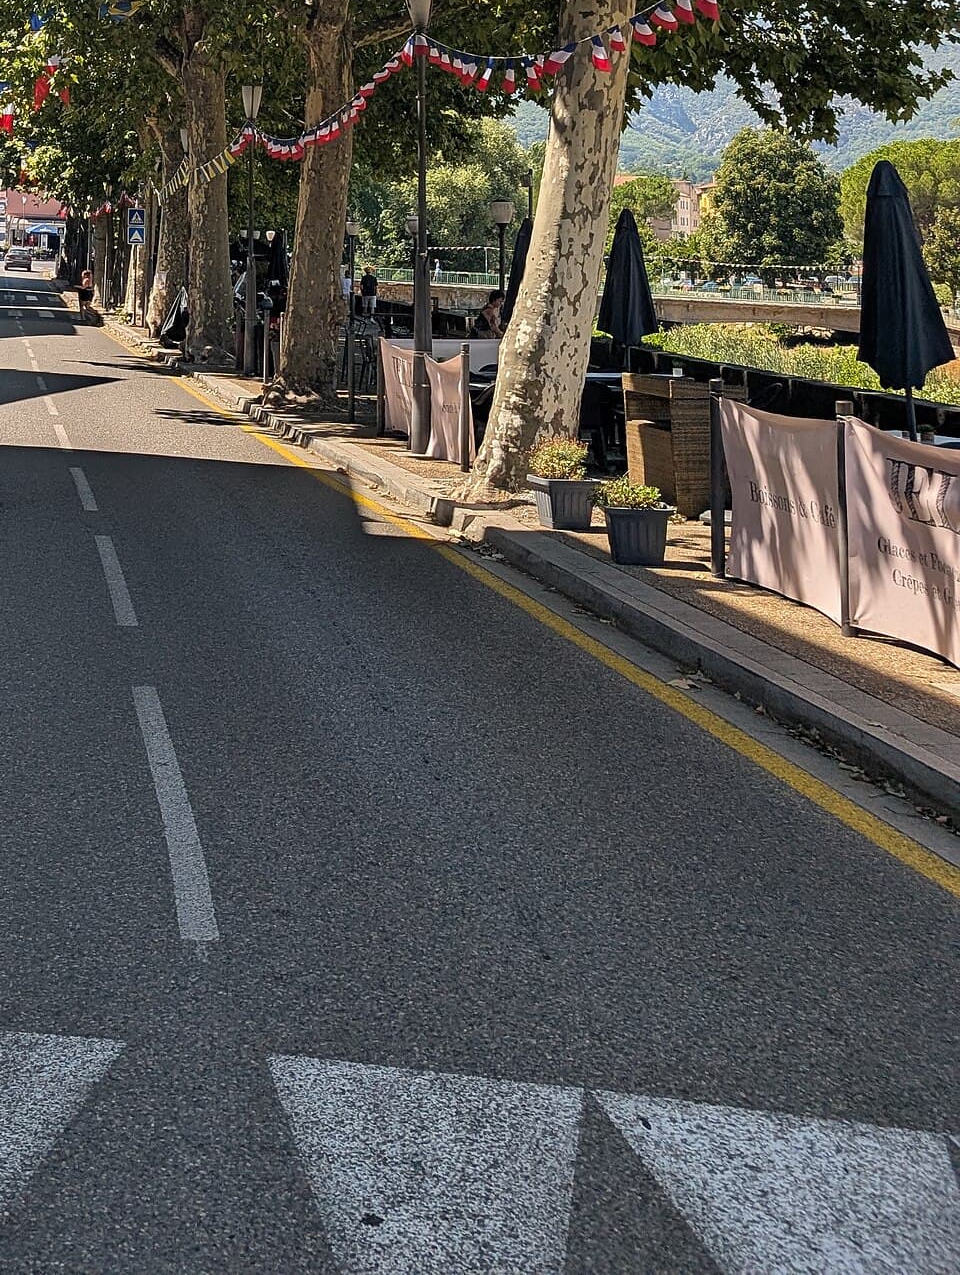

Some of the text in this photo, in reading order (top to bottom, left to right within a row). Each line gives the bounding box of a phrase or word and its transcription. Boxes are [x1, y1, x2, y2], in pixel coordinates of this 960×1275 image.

[749, 481, 836, 529] Boissons & Café
[877, 536, 917, 563] Glaces
[919, 552, 929, 567] et
[892, 568, 929, 596] Crêpes
[931, 586, 942, 601] et
